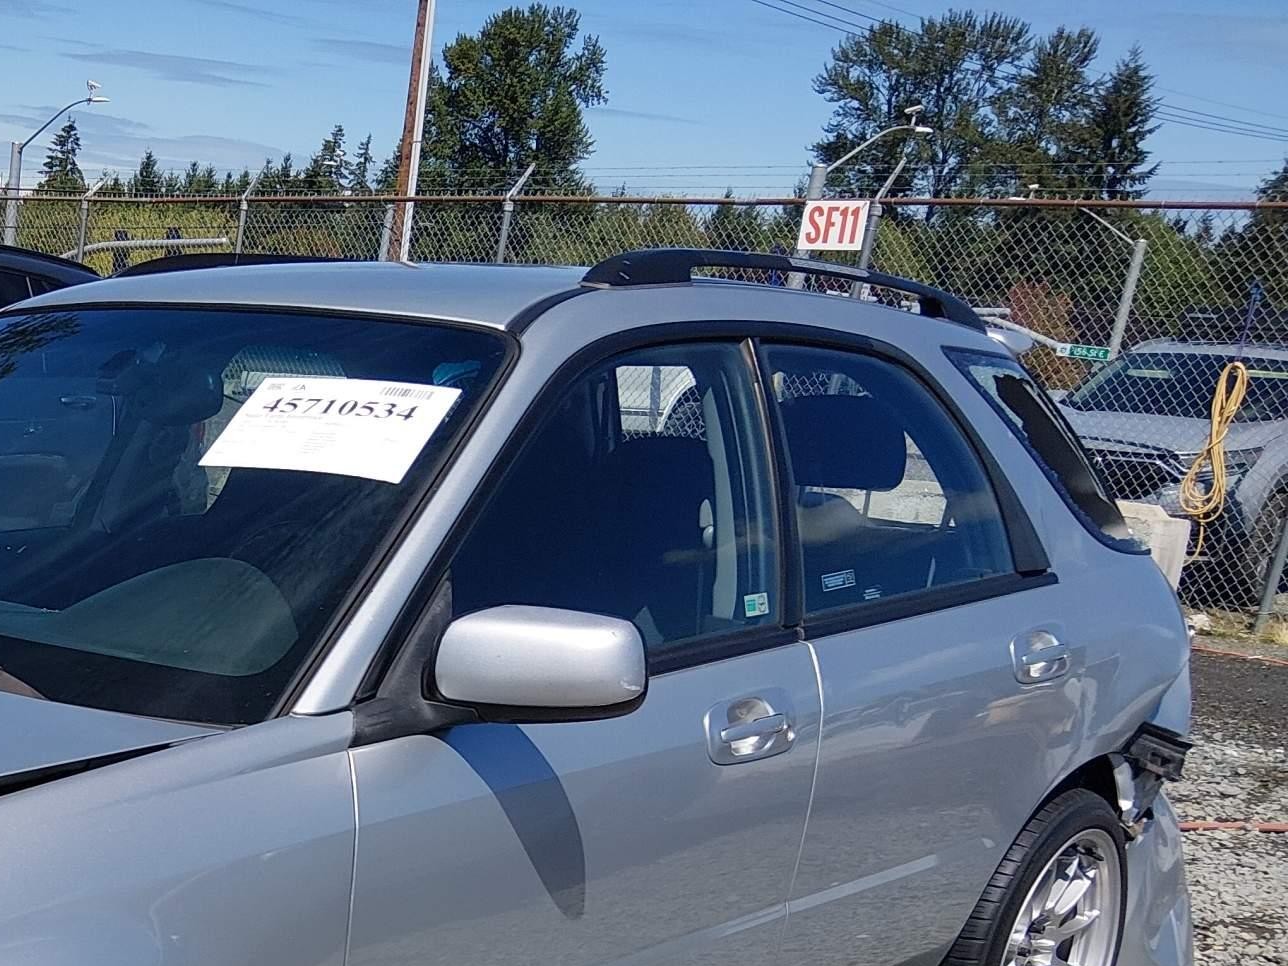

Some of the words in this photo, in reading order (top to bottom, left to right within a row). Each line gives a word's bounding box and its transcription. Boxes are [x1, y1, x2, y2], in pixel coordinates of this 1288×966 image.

[805, 205, 861, 244] SF11
[1098, 350, 1106, 358] E
[263, 397, 420, 421] 45710534
